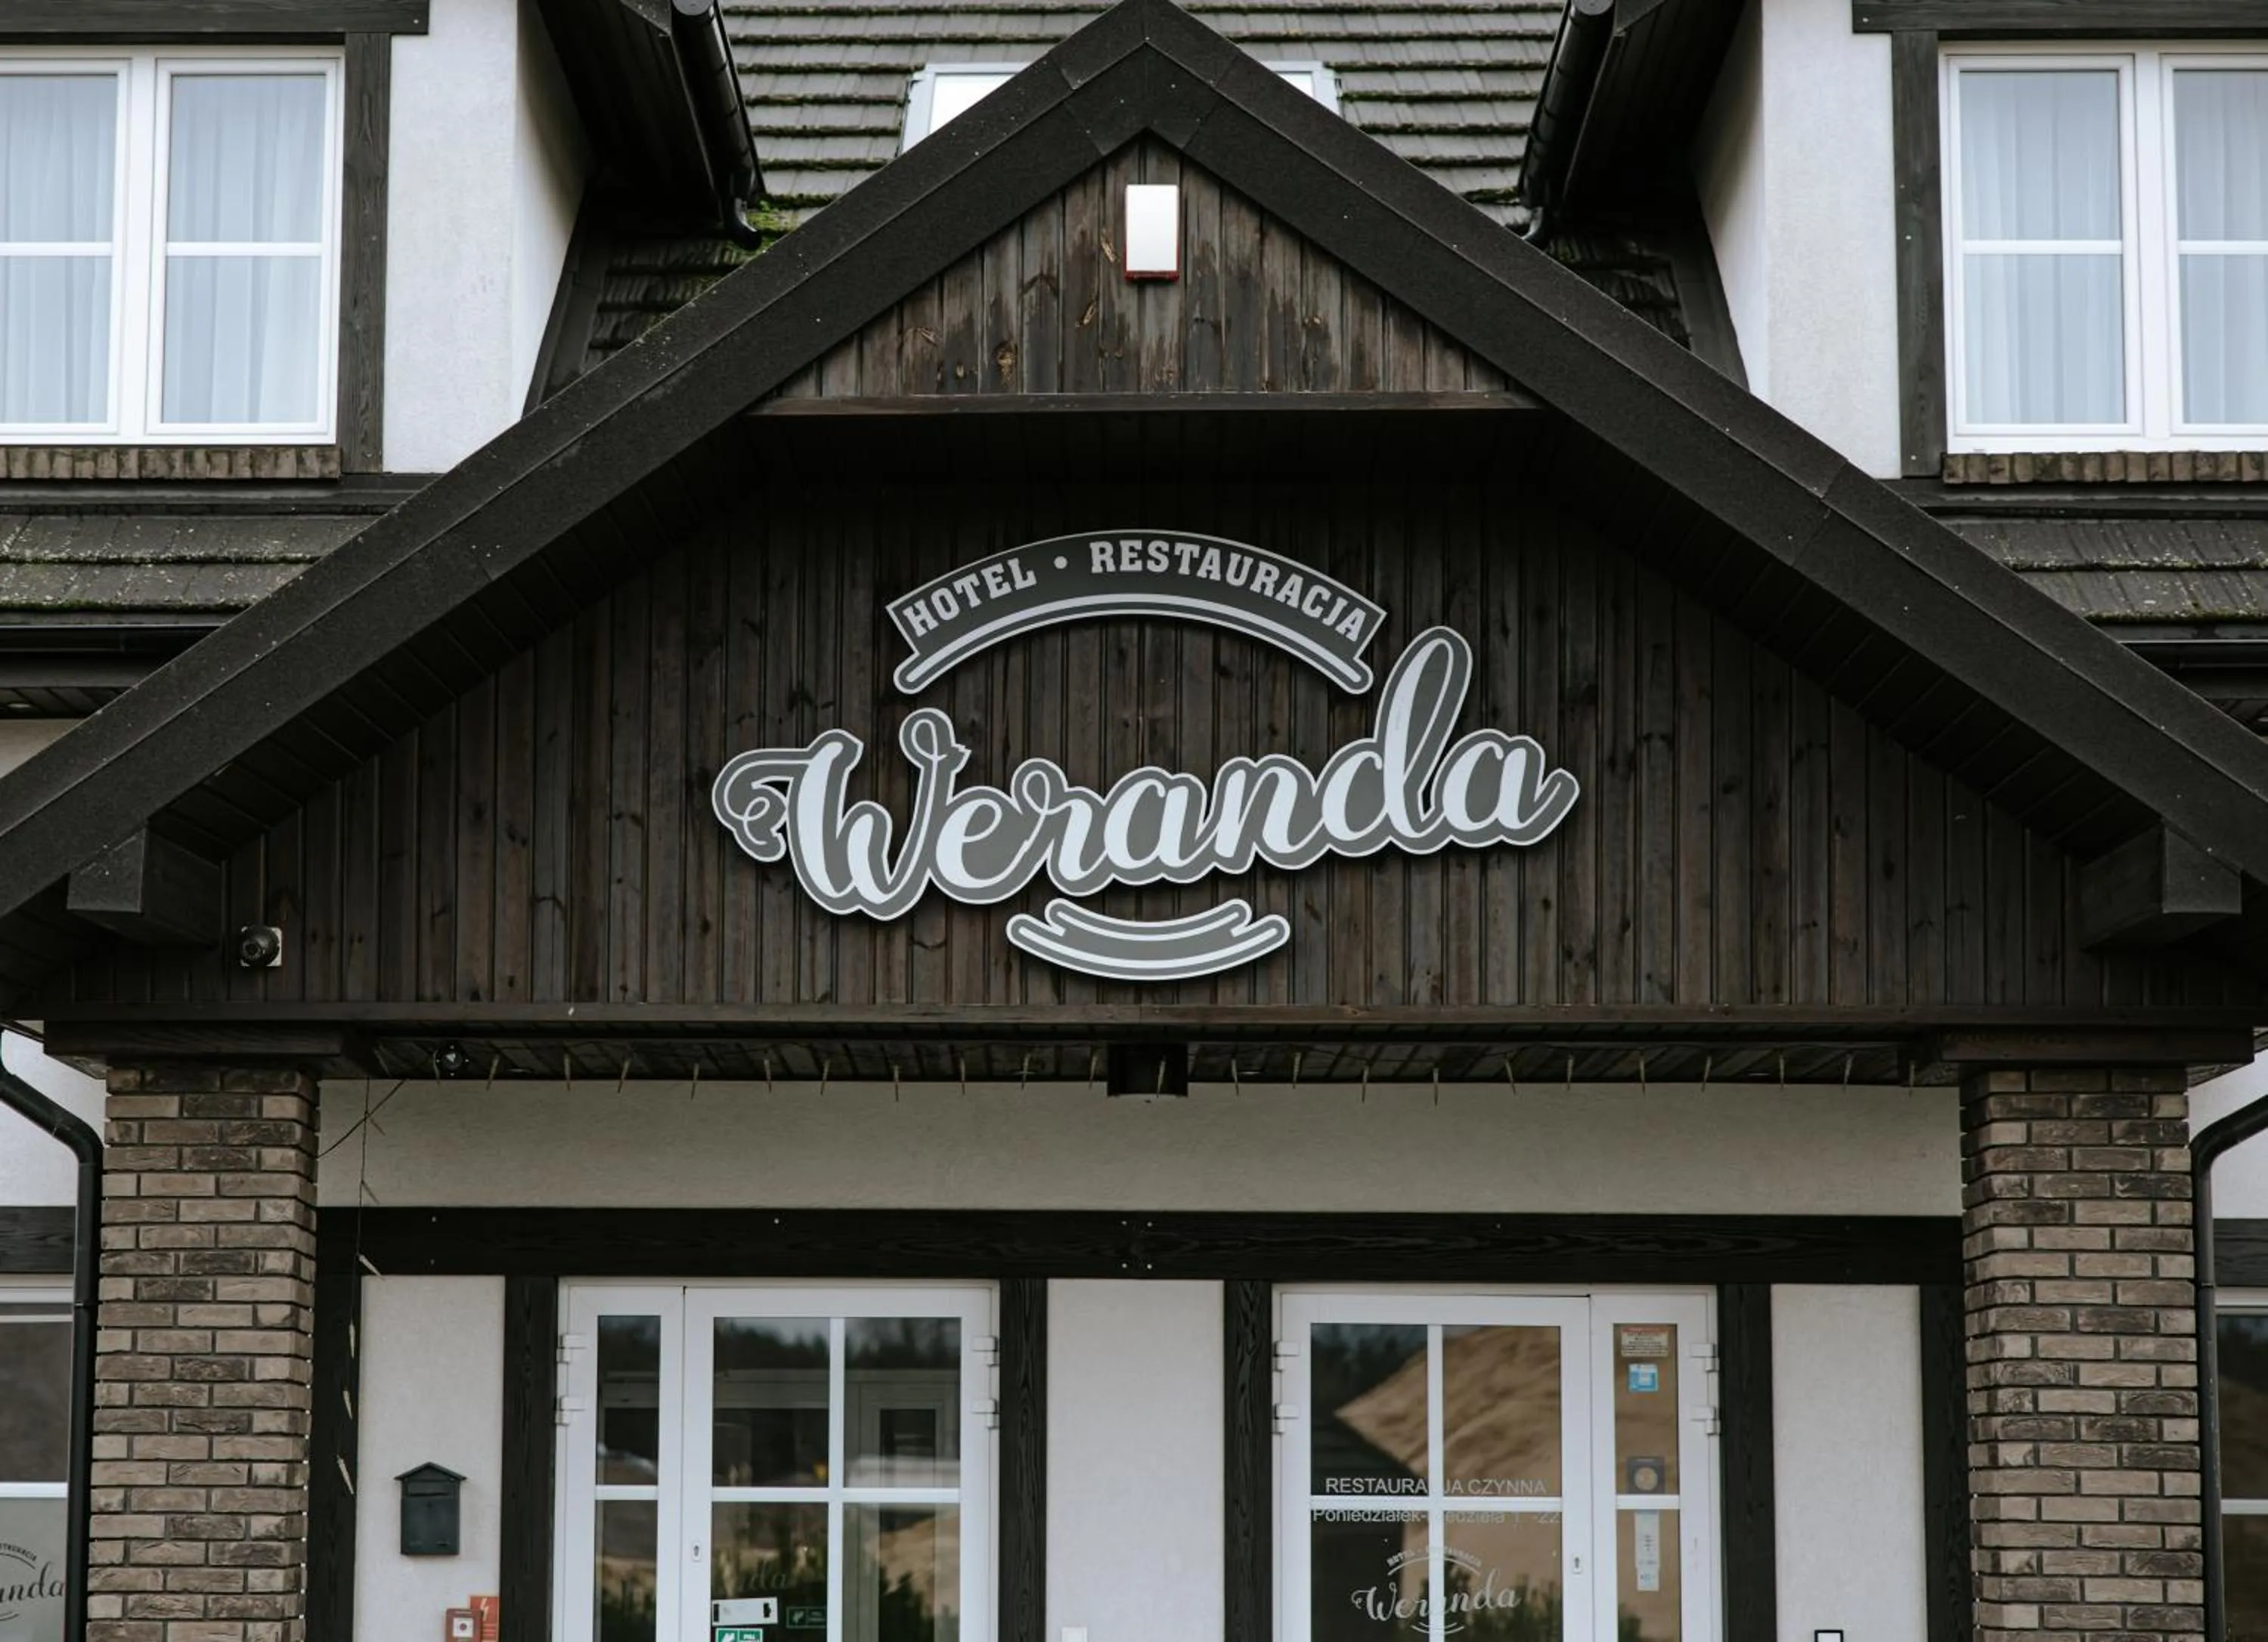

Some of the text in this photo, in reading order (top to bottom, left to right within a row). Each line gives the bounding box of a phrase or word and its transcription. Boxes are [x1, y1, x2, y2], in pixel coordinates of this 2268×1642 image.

[902, 539, 1367, 643] HOTEL RESTAURACJA
[723, 634, 1571, 909] Weranda
[1325, 1478, 1547, 1495] RESTAURAJA CZYNNA
[1351, 1568, 1520, 1622] Wernda
